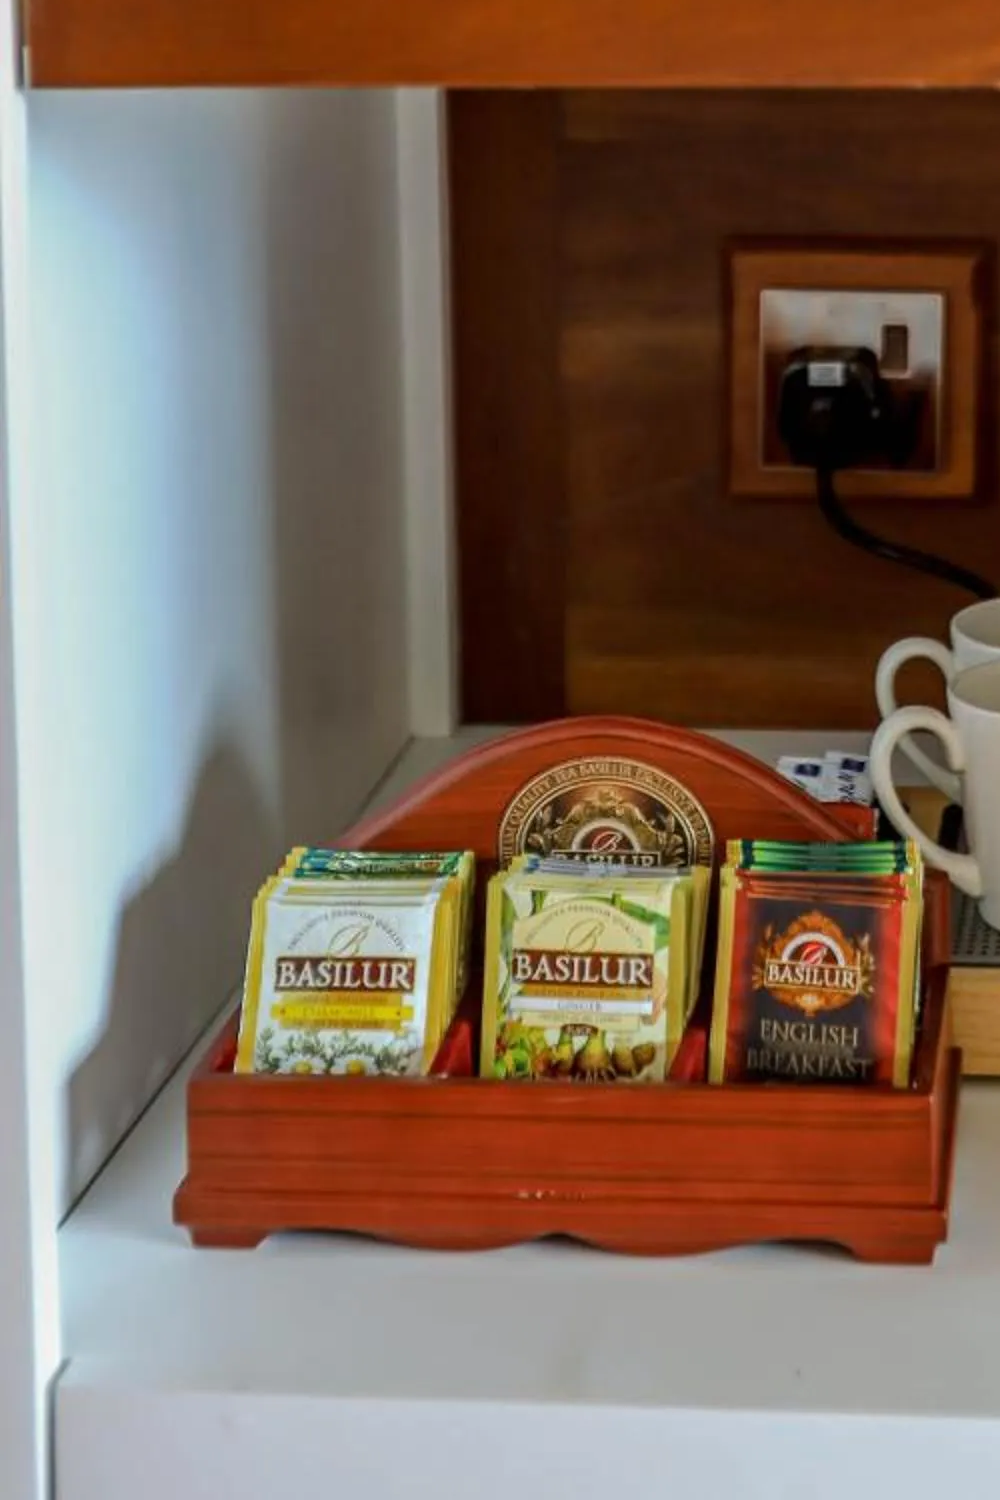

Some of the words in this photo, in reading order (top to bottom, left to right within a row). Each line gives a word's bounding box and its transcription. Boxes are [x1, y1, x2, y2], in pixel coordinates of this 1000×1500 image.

[278, 961, 412, 989] BASILUR
[515, 953, 651, 985] BASILUR
[768, 964, 856, 988] BASILUR
[760, 1017, 859, 1048] ENGLISH
[747, 1047, 873, 1078] BREAKFAST
